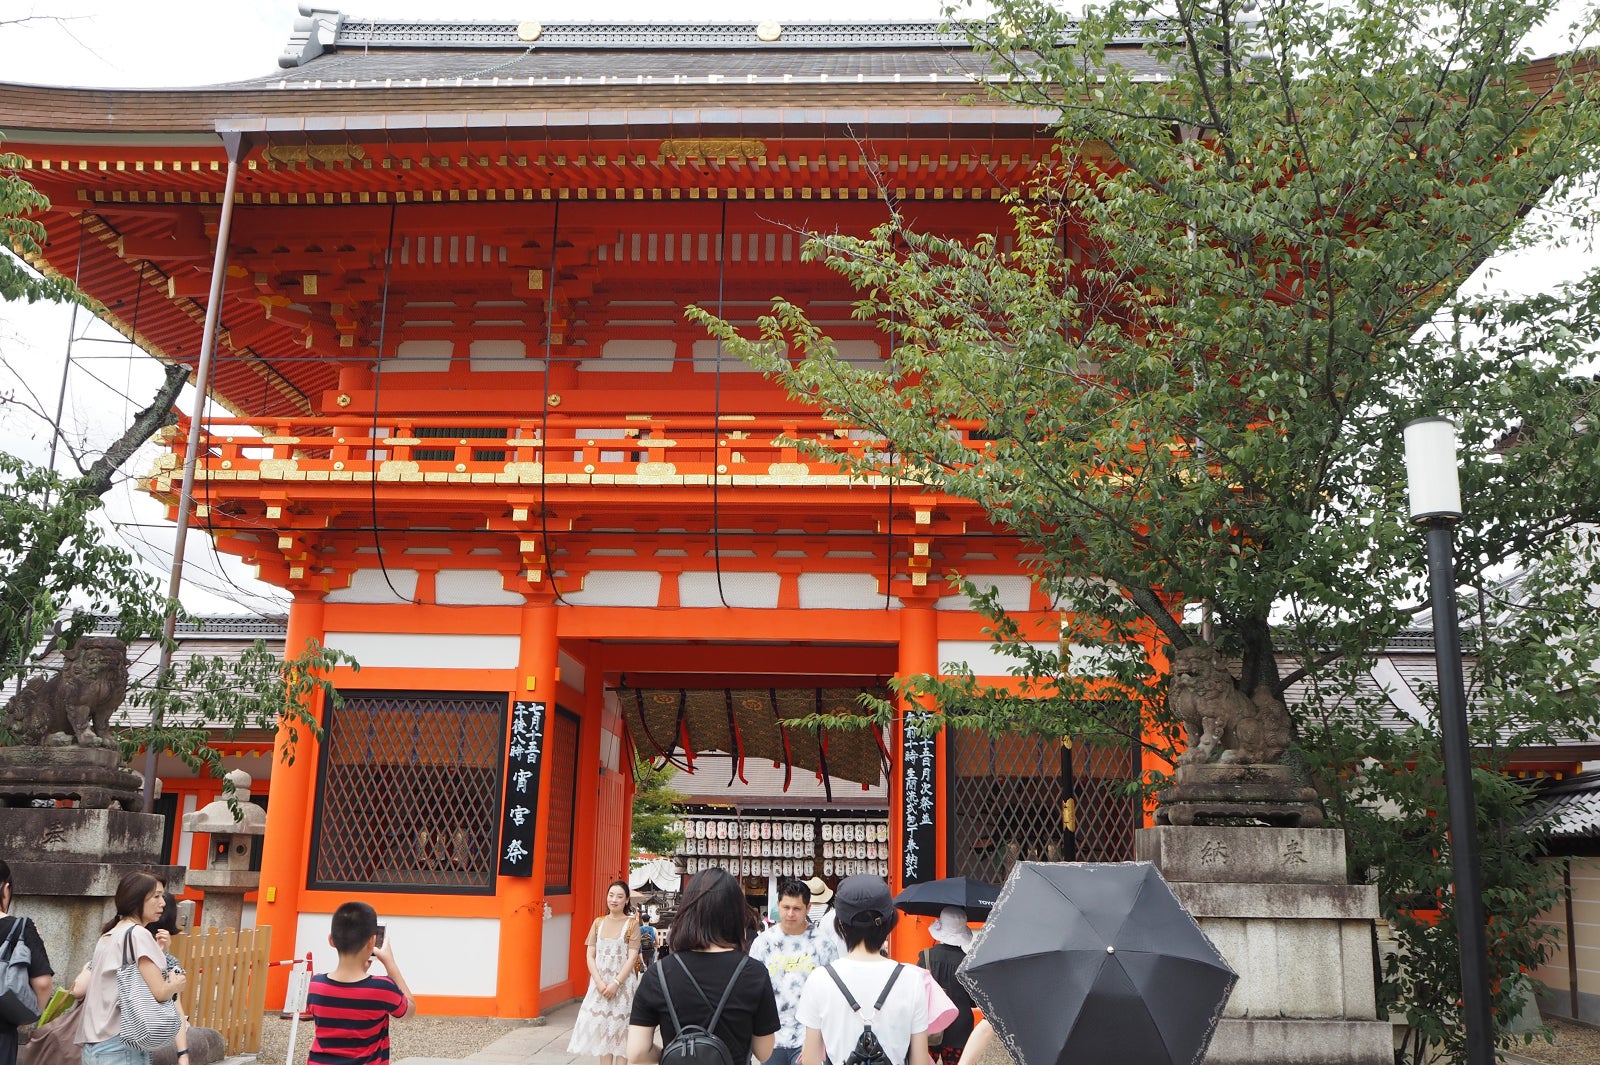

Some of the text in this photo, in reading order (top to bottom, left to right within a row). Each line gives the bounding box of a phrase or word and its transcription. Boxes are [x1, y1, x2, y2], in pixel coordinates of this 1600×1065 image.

[509, 702, 529, 762] 午後八時
[504, 768, 534, 865] 宵宮祭
